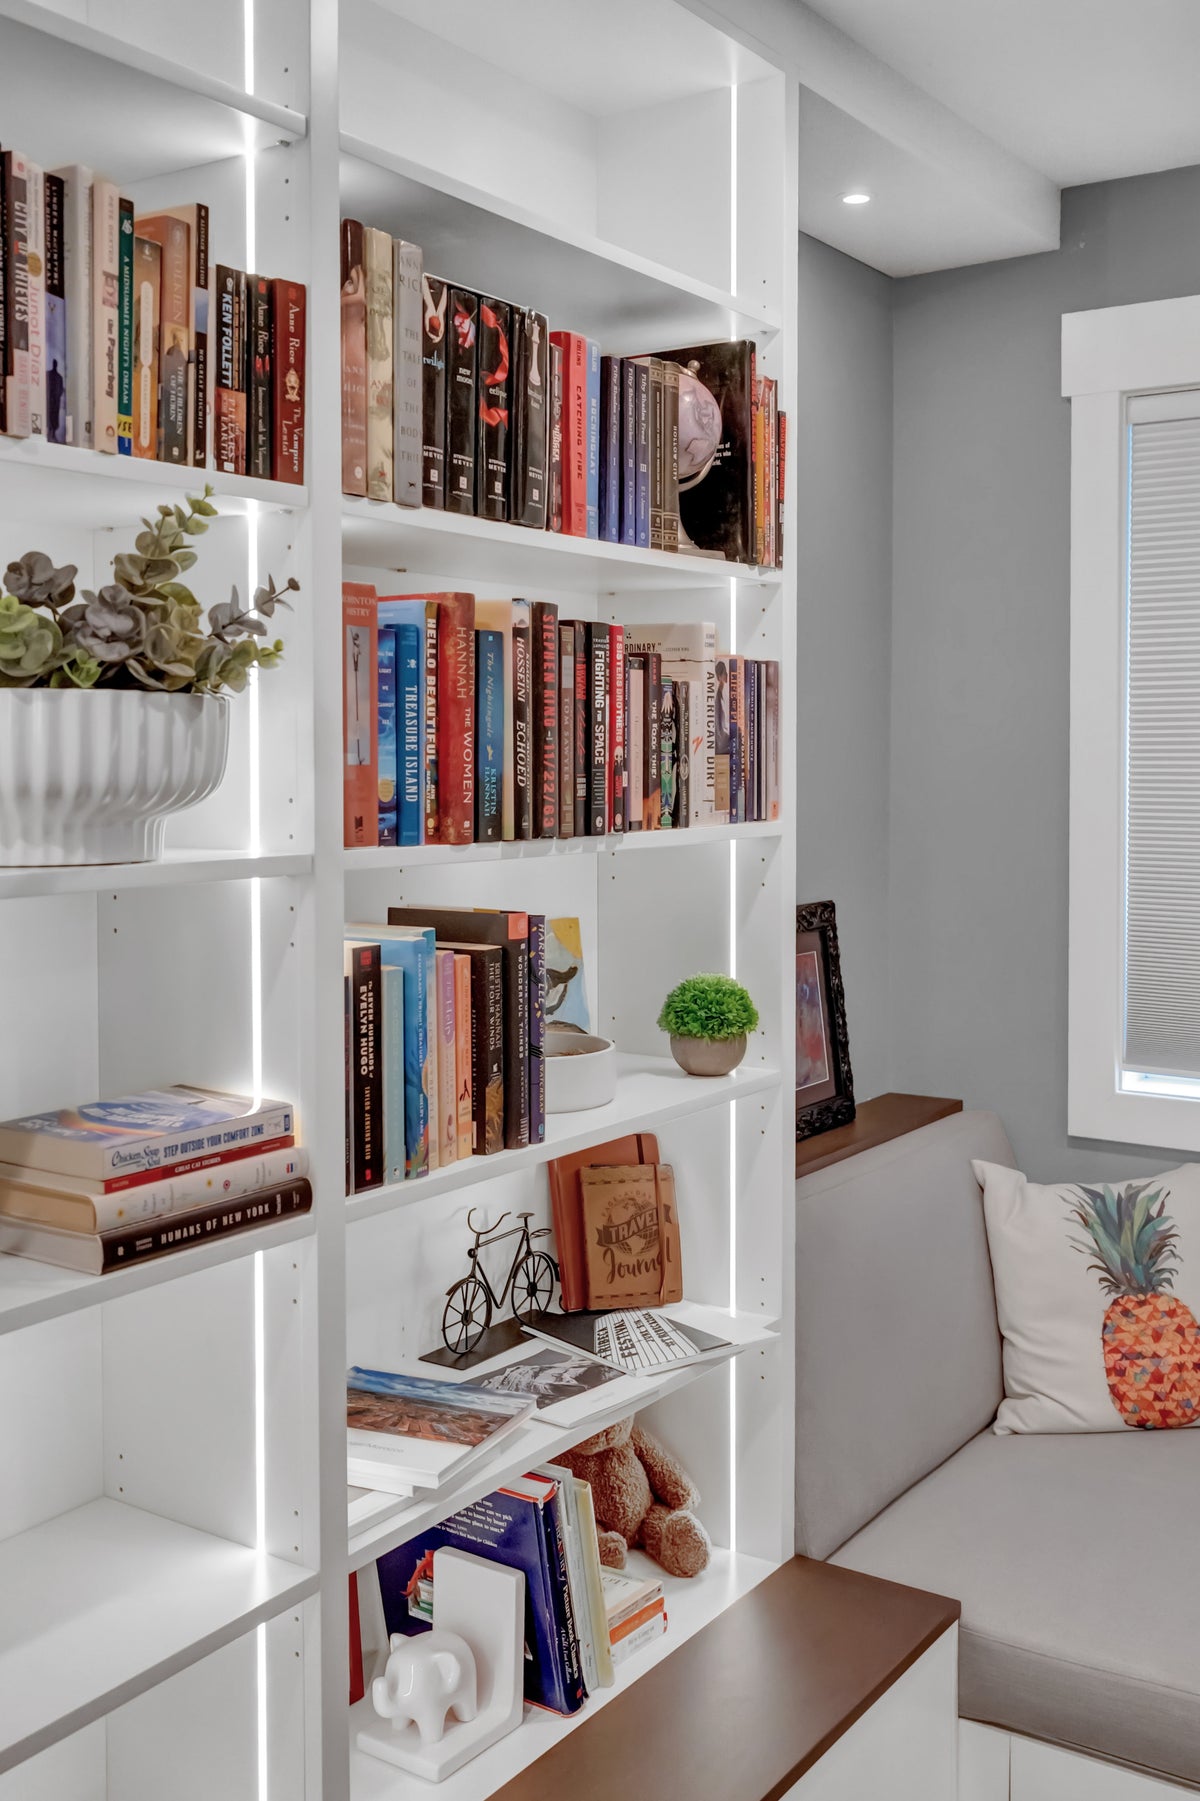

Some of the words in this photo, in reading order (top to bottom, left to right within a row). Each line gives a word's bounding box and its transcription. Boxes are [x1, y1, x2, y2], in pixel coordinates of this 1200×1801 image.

[14, 201, 28, 237] CITY
[15, 262, 28, 322] THIEVES
[30, 281, 40, 336] Junot
[222, 293, 232, 326] KEN
[258, 300, 268, 327] Anne
[289, 302, 300, 332] Anne
[198, 348, 204, 361] NO
[222, 328, 232, 386] FOLLETT
[258, 330, 268, 353] Rice
[289, 337, 300, 363] Rice
[105, 337, 116, 398] Paperboy
[170, 375, 176, 386] OF
[456, 375, 473, 387] moon
[459, 367, 472, 376] new
[228, 398, 236, 458] PILLARS
[282, 420, 293, 456] Lestat
[290, 427, 303, 472] Vampire
[423, 451, 444, 460] MEYER
[453, 459, 473, 467] MEYER
[488, 464, 506, 474] MEYER
[528, 471, 543, 480] MEYER
[427, 618, 436, 668] HELLO
[457, 626, 467, 698] HANNAH
[543, 614, 555, 682] STEPHEN
[517, 637, 525, 702] HOSSEINI
[595, 650, 605, 708] FIGHTING
[405, 685, 417, 751] TREASURE
[427, 675, 436, 763] BEAUTIFUL
[486, 675, 494, 738] Nightingale
[543, 689, 555, 727] KING
[707, 671, 715, 750] AMERICAN
[731, 712, 737, 722] PI
[516, 720, 526, 787] ECHOED
[595, 724, 605, 765] SPACE
[405, 756, 417, 802] ISLAND
[463, 731, 472, 803] WOMEN
[543, 744, 555, 827] 11/22/63
[360, 985, 368, 1034] EVELYN
[539, 1022, 544, 1033] GO
[360, 1038, 368, 1075] HUGO
[112, 1151, 142, 1167] Chicken
[144, 1145, 160, 1157] Soup
[164, 1144, 179, 1158] STEP
[180, 1138, 205, 1154] OUTSIDE
[206, 1134, 222, 1148] YOUR
[223, 1127, 250, 1144] COMFORT
[251, 1124, 264, 1137] ZONE
[145, 1156, 161, 1170] Soul
[161, 1223, 201, 1244] HUMANS
[206, 1218, 218, 1231] OF
[222, 1211, 242, 1225] NEW
[246, 1204, 270, 1219] YORK
[597, 1326, 612, 1359] TRIBECA
[613, 1318, 639, 1359] FESTIVAL
[563, 1584, 571, 1618] Picture
[570, 1642, 578, 1680] Classics
